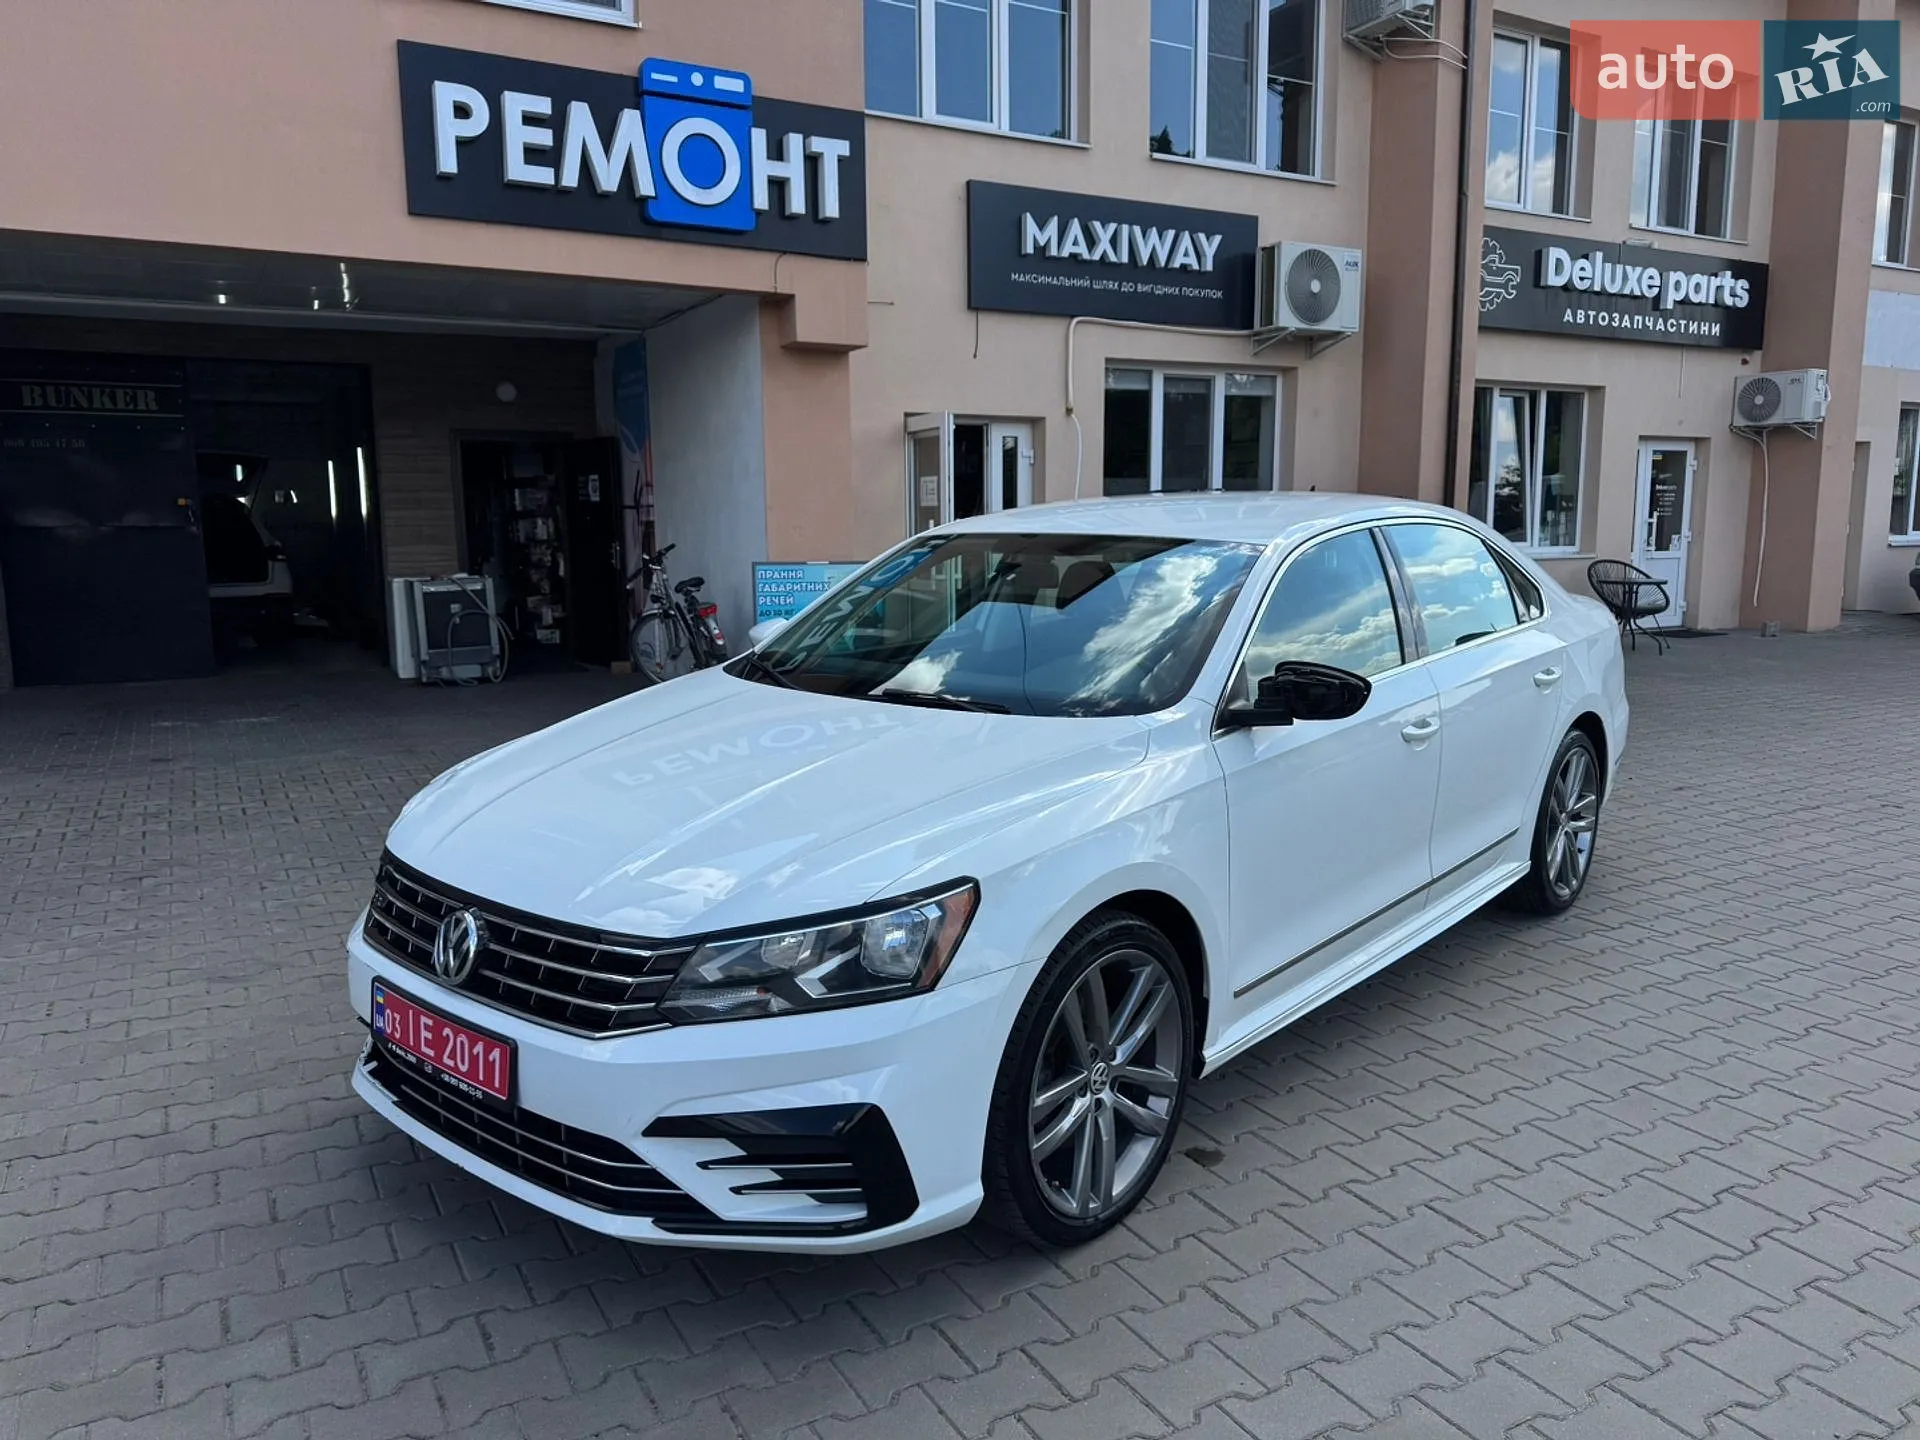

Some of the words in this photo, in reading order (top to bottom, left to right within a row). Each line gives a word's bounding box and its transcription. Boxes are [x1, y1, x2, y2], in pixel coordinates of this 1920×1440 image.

[432, 80, 850, 221] РЕМОНТ
[1021, 211, 1223, 272] MAXIWAY
[1011, 272, 1090, 288] МАКСИМАЛЬНИЙ
[1092, 278, 1119, 291] ШЛЯХ
[1120, 281, 1135, 293] ДО
[1137, 284, 1180, 296] ВИГІДНИХ
[1182, 287, 1223, 299] ПОКУПОК
[1542, 246, 1661, 298] Deluxe
[1662, 270, 1750, 309] parts
[1563, 308, 1721, 337] АВТОЗАПЧАСТИНИ
[21, 384, 159, 410] BUNKER
[758, 570, 804, 579] ПРАННЯ
[758, 582, 830, 592] ГАБАРИТНИХ
[758, 593, 794, 605] РЕЧЕЙ
[385, 1009, 401, 1040] 03
[442, 1027, 501, 1089] 2011
